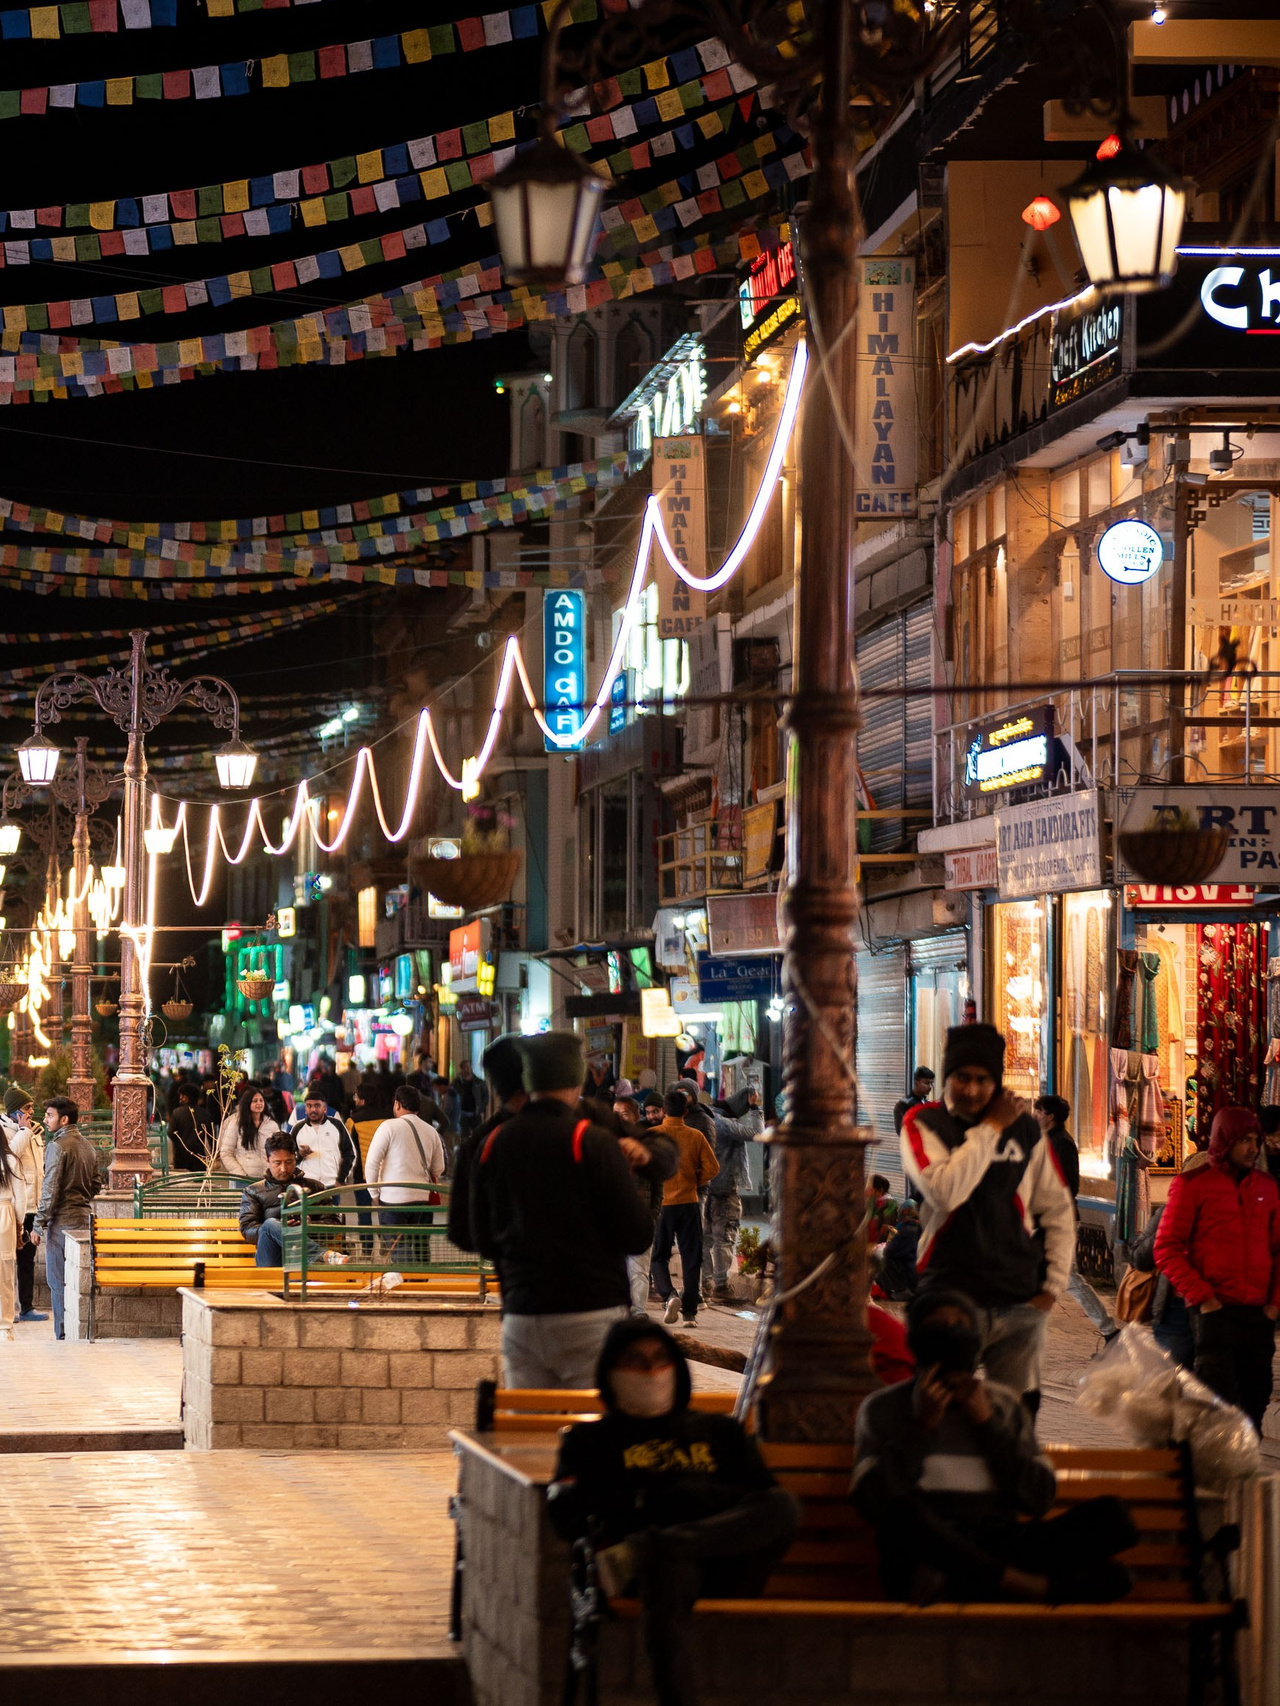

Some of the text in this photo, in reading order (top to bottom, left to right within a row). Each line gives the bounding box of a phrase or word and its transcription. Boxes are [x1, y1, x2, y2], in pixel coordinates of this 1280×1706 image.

[1082, 306, 1119, 361] Kitchen
[867, 292, 899, 485] HIMALAYAN
[856, 492, 912, 514] CAFE
[666, 464, 691, 612] HIMALAAN
[554, 593, 575, 666] AMDO
[1240, 850, 1280, 869] PA
[462, 1001, 486, 1012] ATM
